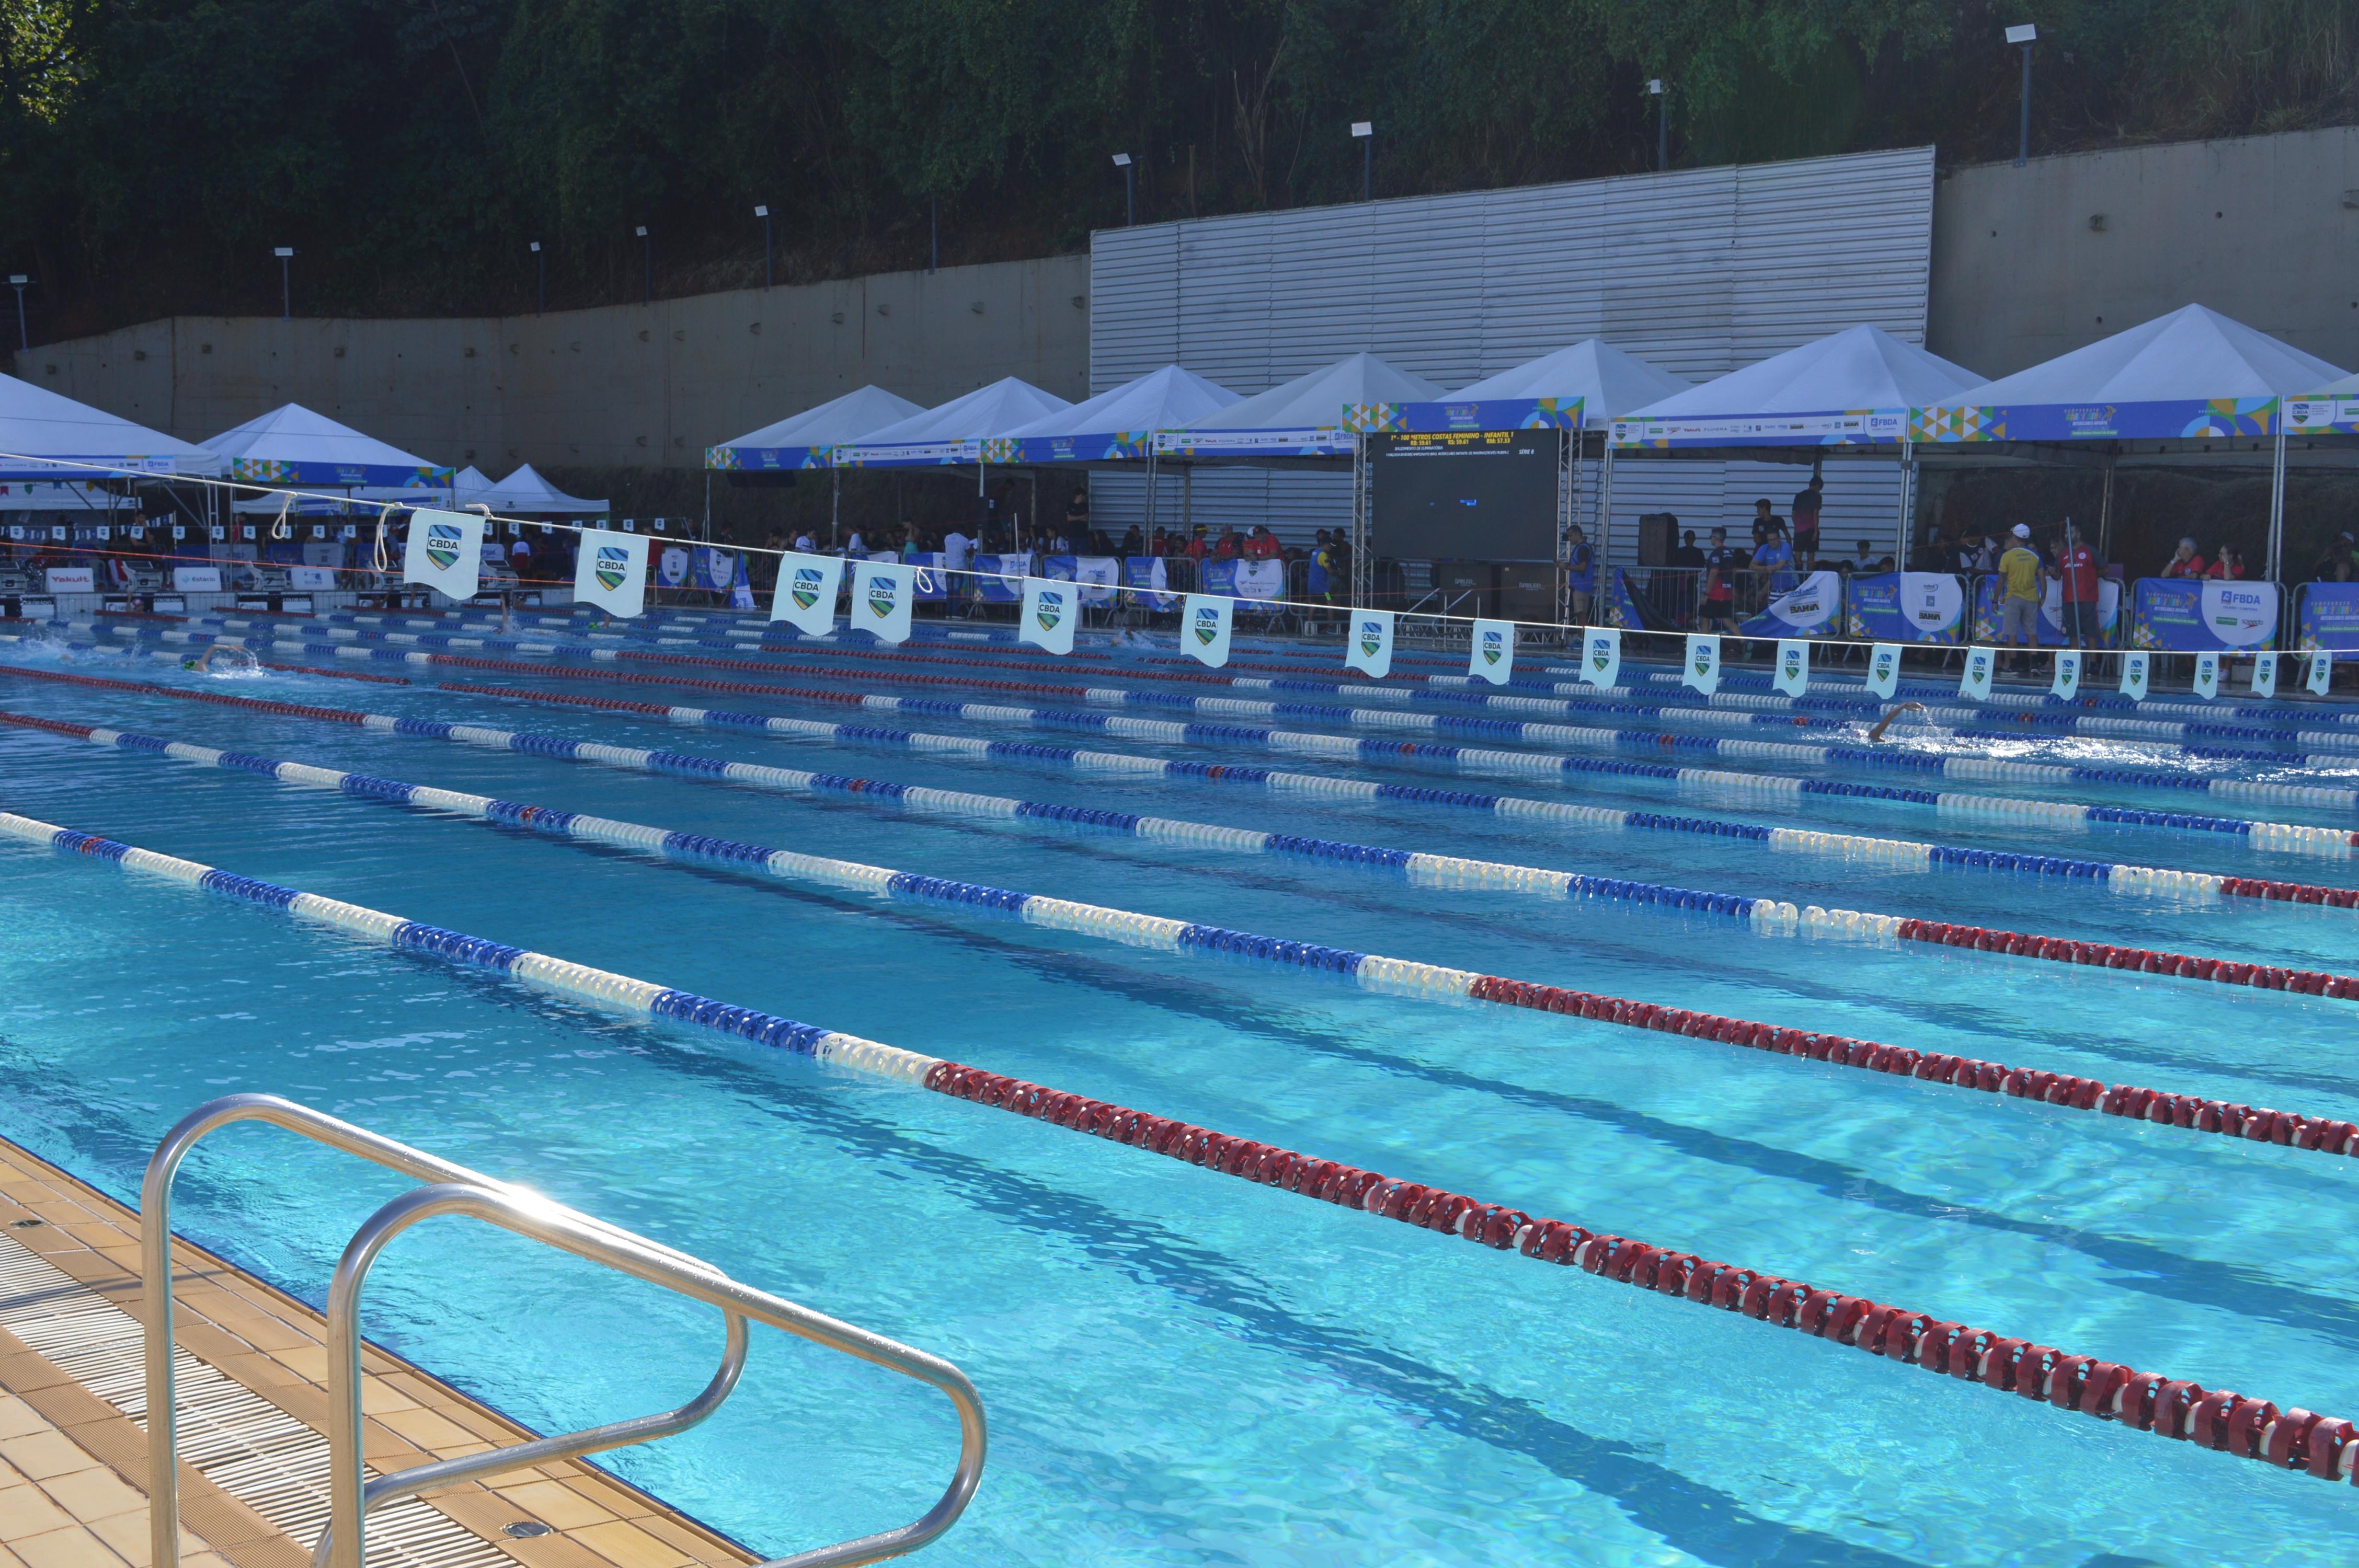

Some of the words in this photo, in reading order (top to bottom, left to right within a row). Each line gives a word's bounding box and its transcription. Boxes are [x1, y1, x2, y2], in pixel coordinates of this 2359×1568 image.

[429, 539, 458, 550] CBDA
[598, 560, 625, 571] CBDA
[795, 581, 819, 592] CBDA
[871, 590, 894, 599] CBDA
[2233, 594, 2260, 605] FBDA
[1039, 604, 1060, 614] CBDA
[1790, 603, 1819, 614] BAHIA
[1197, 620, 1216, 628] CBDA
[1362, 633, 1380, 641] CBDA
[1484, 642, 1502, 650] CBDA
[1594, 649, 1609, 658] CBDA
